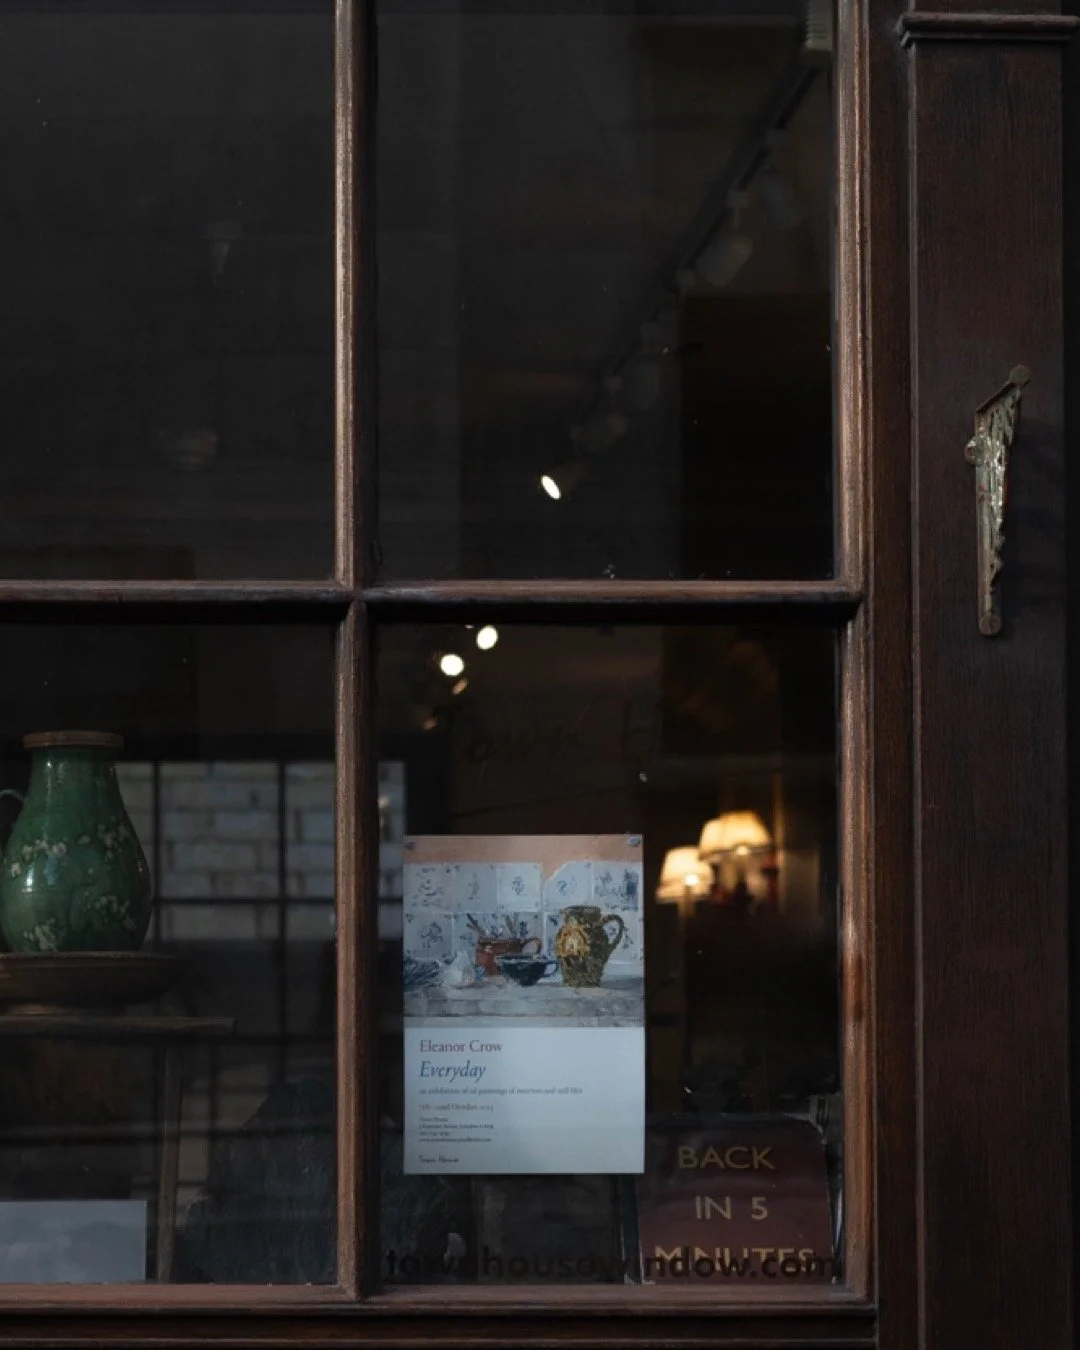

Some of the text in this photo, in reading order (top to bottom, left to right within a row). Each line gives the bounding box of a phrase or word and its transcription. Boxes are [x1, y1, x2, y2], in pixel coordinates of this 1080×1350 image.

[420, 1039, 502, 1052] Eleanor Crow
[420, 1060, 487, 1083] Everyday
[678, 1146, 776, 1170] BACK
[695, 1196, 769, 1220] IN 5
[386, 1245, 836, 1278] towhousewindow.com
